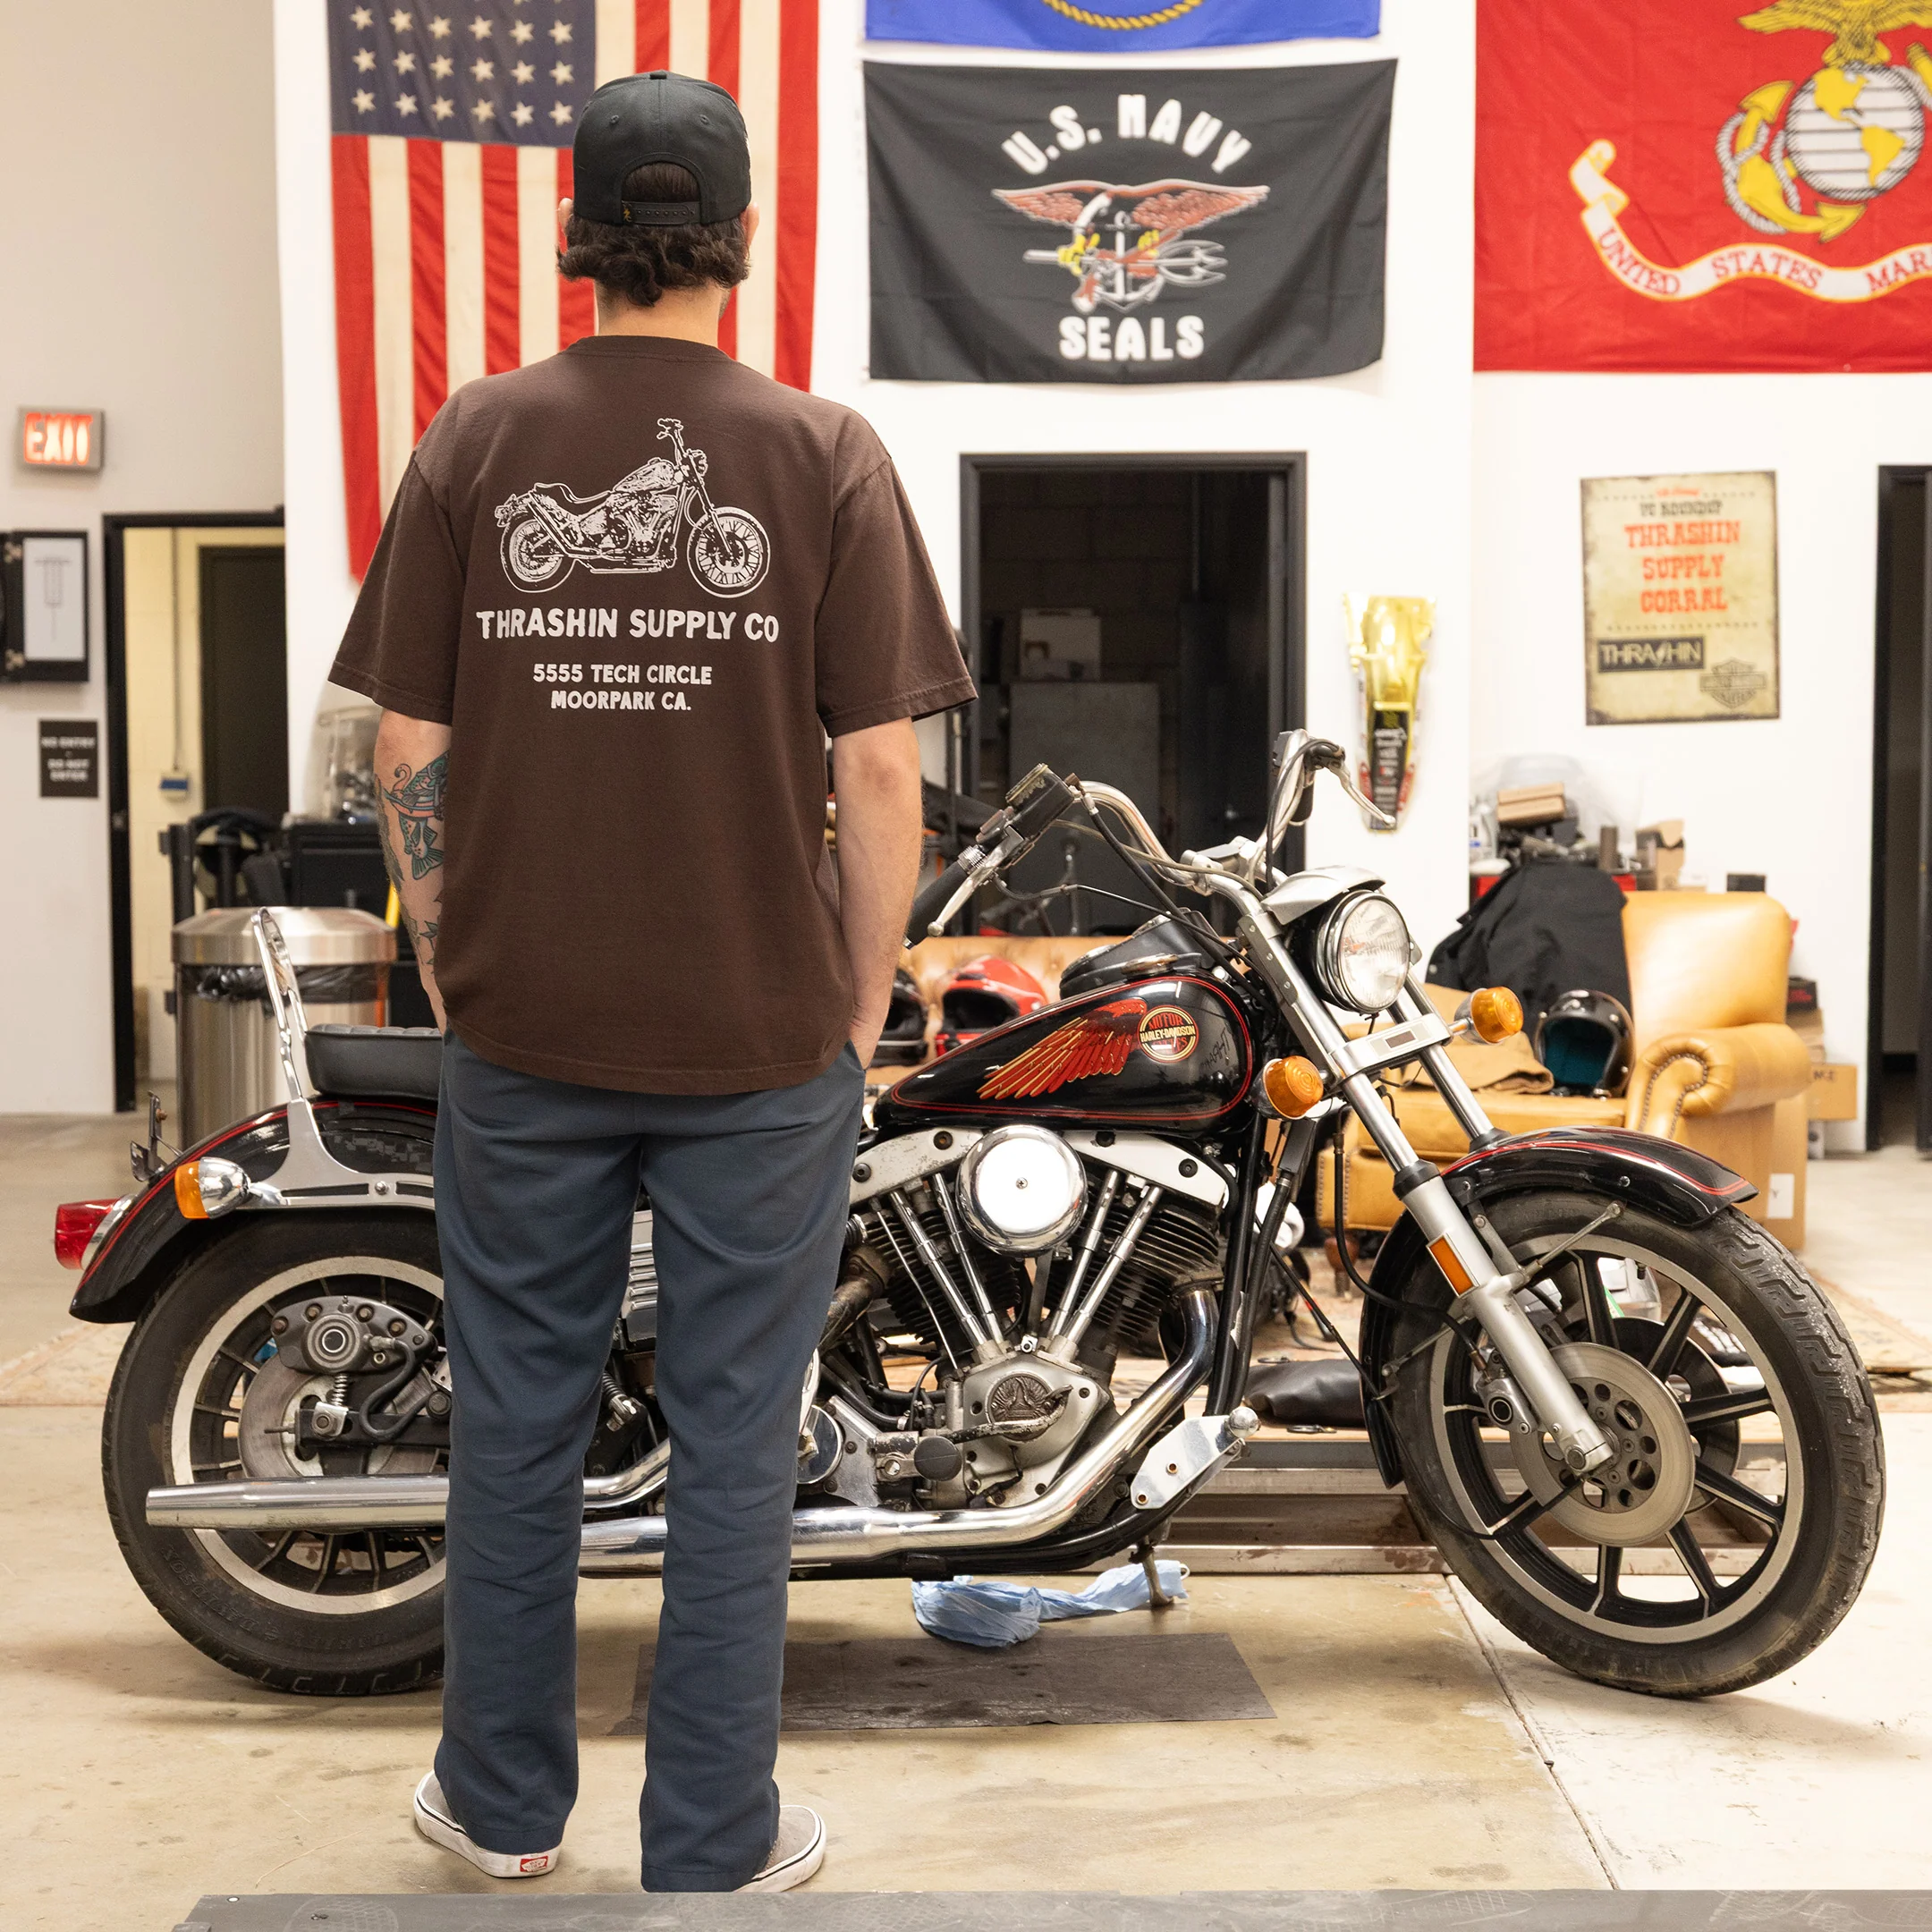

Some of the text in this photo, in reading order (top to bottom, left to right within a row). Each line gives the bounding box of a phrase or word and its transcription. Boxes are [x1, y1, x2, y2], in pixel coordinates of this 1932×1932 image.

[1001, 94, 1253, 175] U.S. NAVY
[1599, 226, 1932, 295] UNITED STATES MAR
[1059, 315, 1205, 362] SEALS
[24, 412, 93, 466] EXIT
[1623, 521, 1741, 548] THRASHIN
[1642, 554, 1724, 580] SUPPLY
[1640, 587, 1728, 614] CORRAL
[476, 608, 780, 643] THRASHIN SUPPLY CO
[533, 664, 713, 685] 5555 TECH CIRCLE
[551, 691, 692, 711] MOORPARK CA.
[1140, 1025, 1196, 1043] HARLEY-DAVIDSON
[1148, 1012, 1184, 1030] MOTOR
